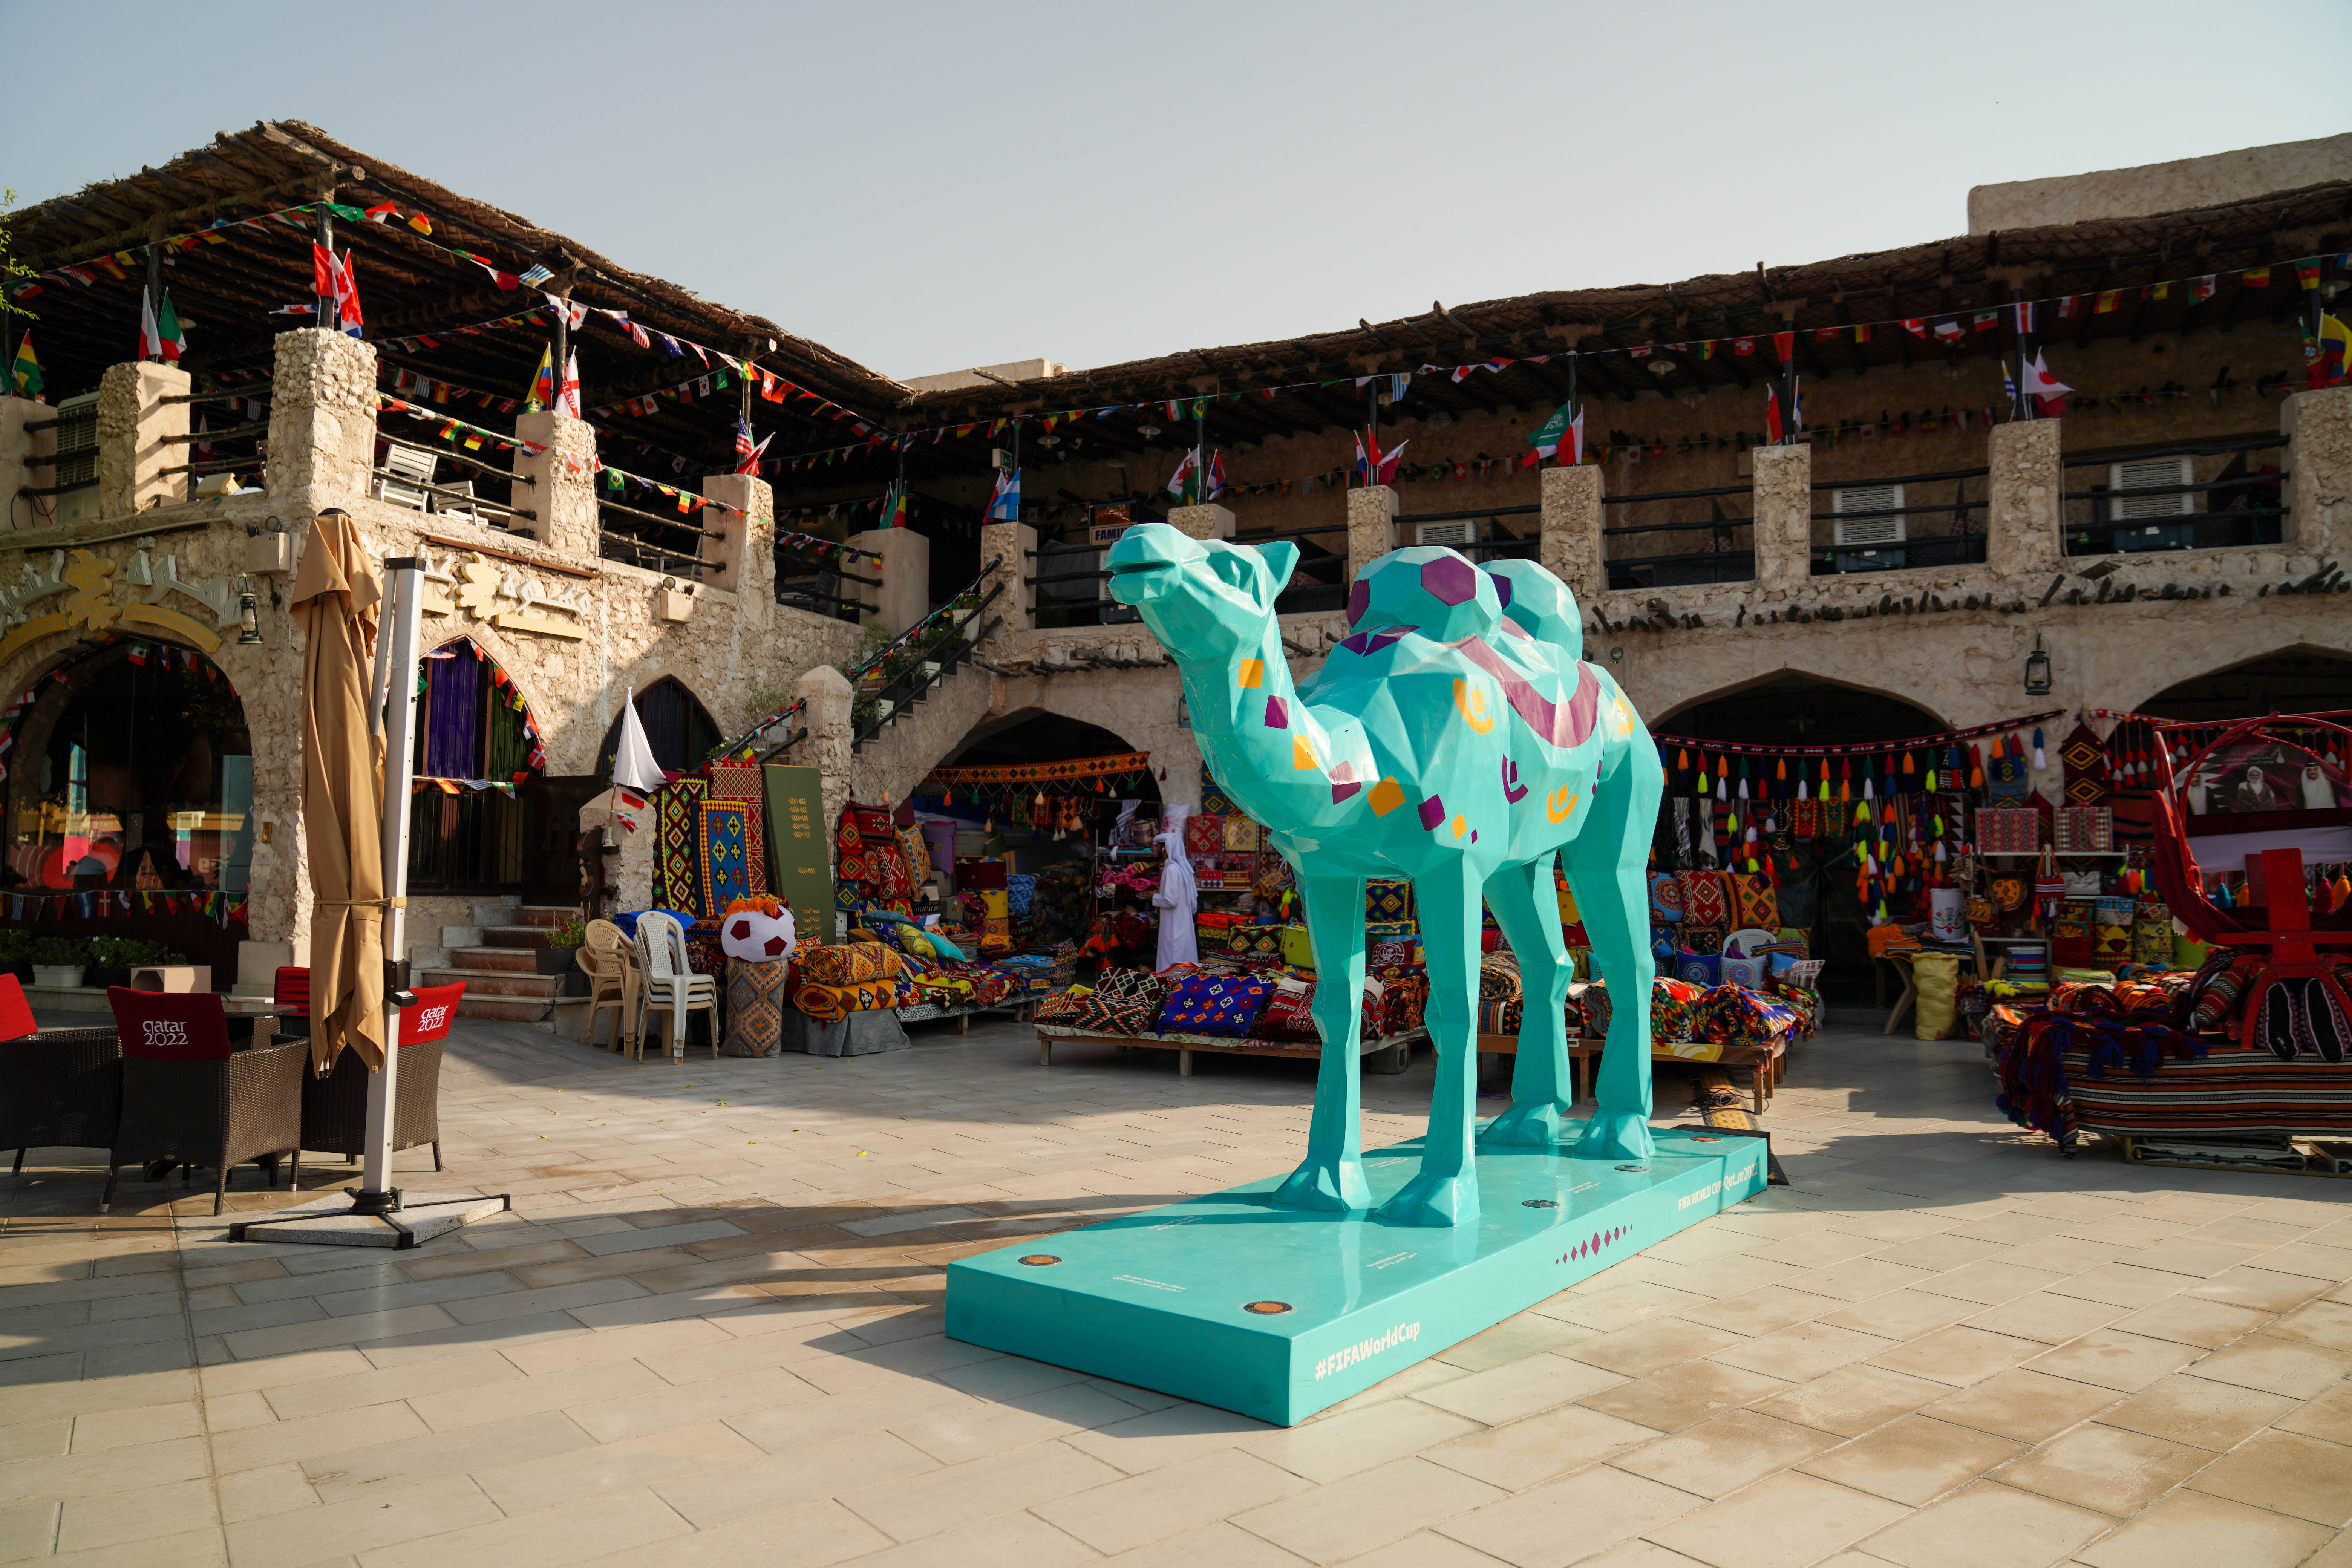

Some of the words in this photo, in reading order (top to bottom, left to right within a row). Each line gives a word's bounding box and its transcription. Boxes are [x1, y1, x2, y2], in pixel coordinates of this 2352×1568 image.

[562, 380, 576, 409] GLAND
[1095, 528, 1127, 541] FAMI
[421, 1004, 449, 1022] qatar
[142, 1018, 187, 1037] qatar
[417, 1016, 444, 1032] 2022
[143, 1033, 188, 1046] 2022
[1678, 1195, 1692, 1211] FIFA
[1691, 1185, 1711, 1204] WORLD
[1712, 1181, 1722, 1195] CUP
[1315, 1321, 1420, 1381] #FIFAWorldCup
